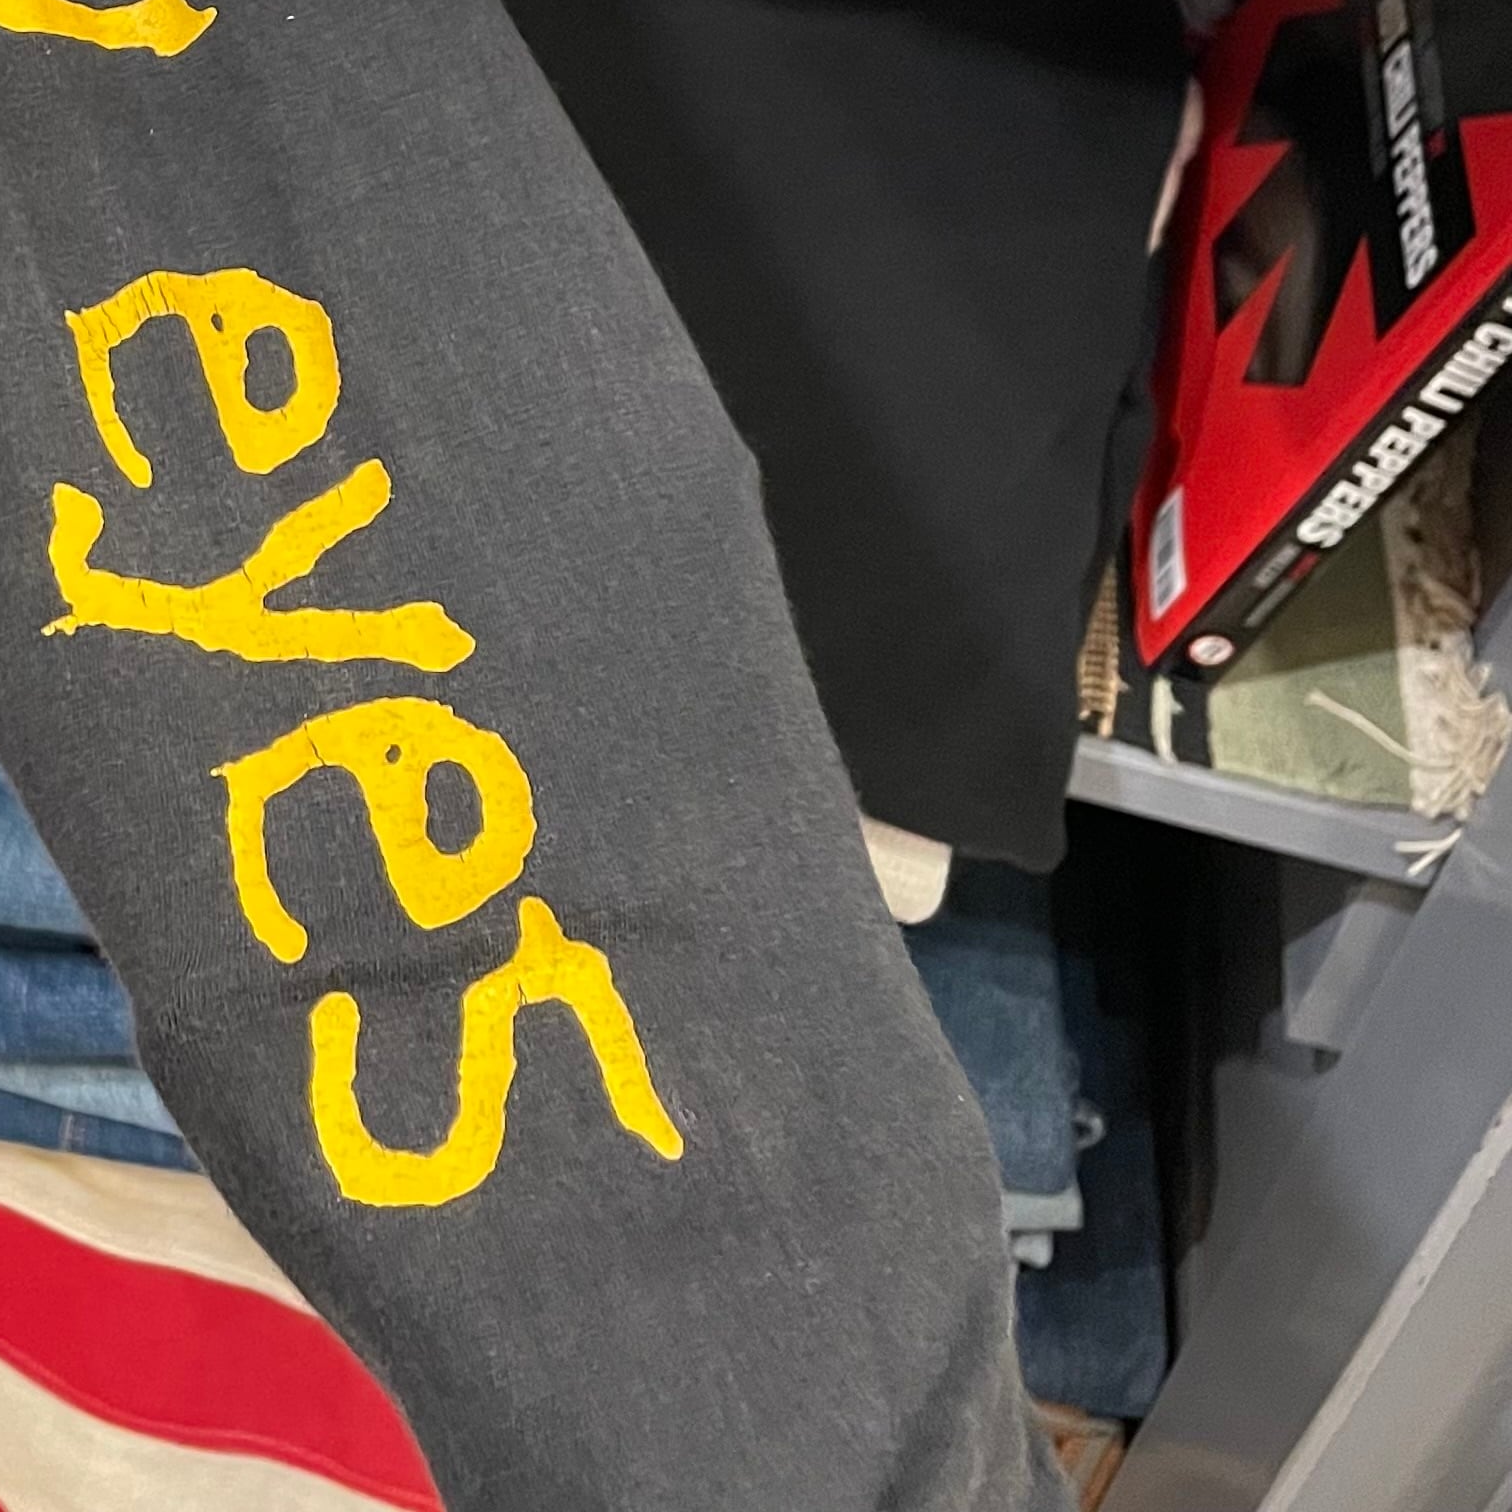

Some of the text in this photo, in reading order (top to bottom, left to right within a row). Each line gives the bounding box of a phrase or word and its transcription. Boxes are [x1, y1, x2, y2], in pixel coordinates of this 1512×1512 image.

[1391, 118, 1439, 290] PEPPERS
[1296, 320, 1512, 549] CHILI PEPPERS
[42, 267, 684, 1210] eyes
